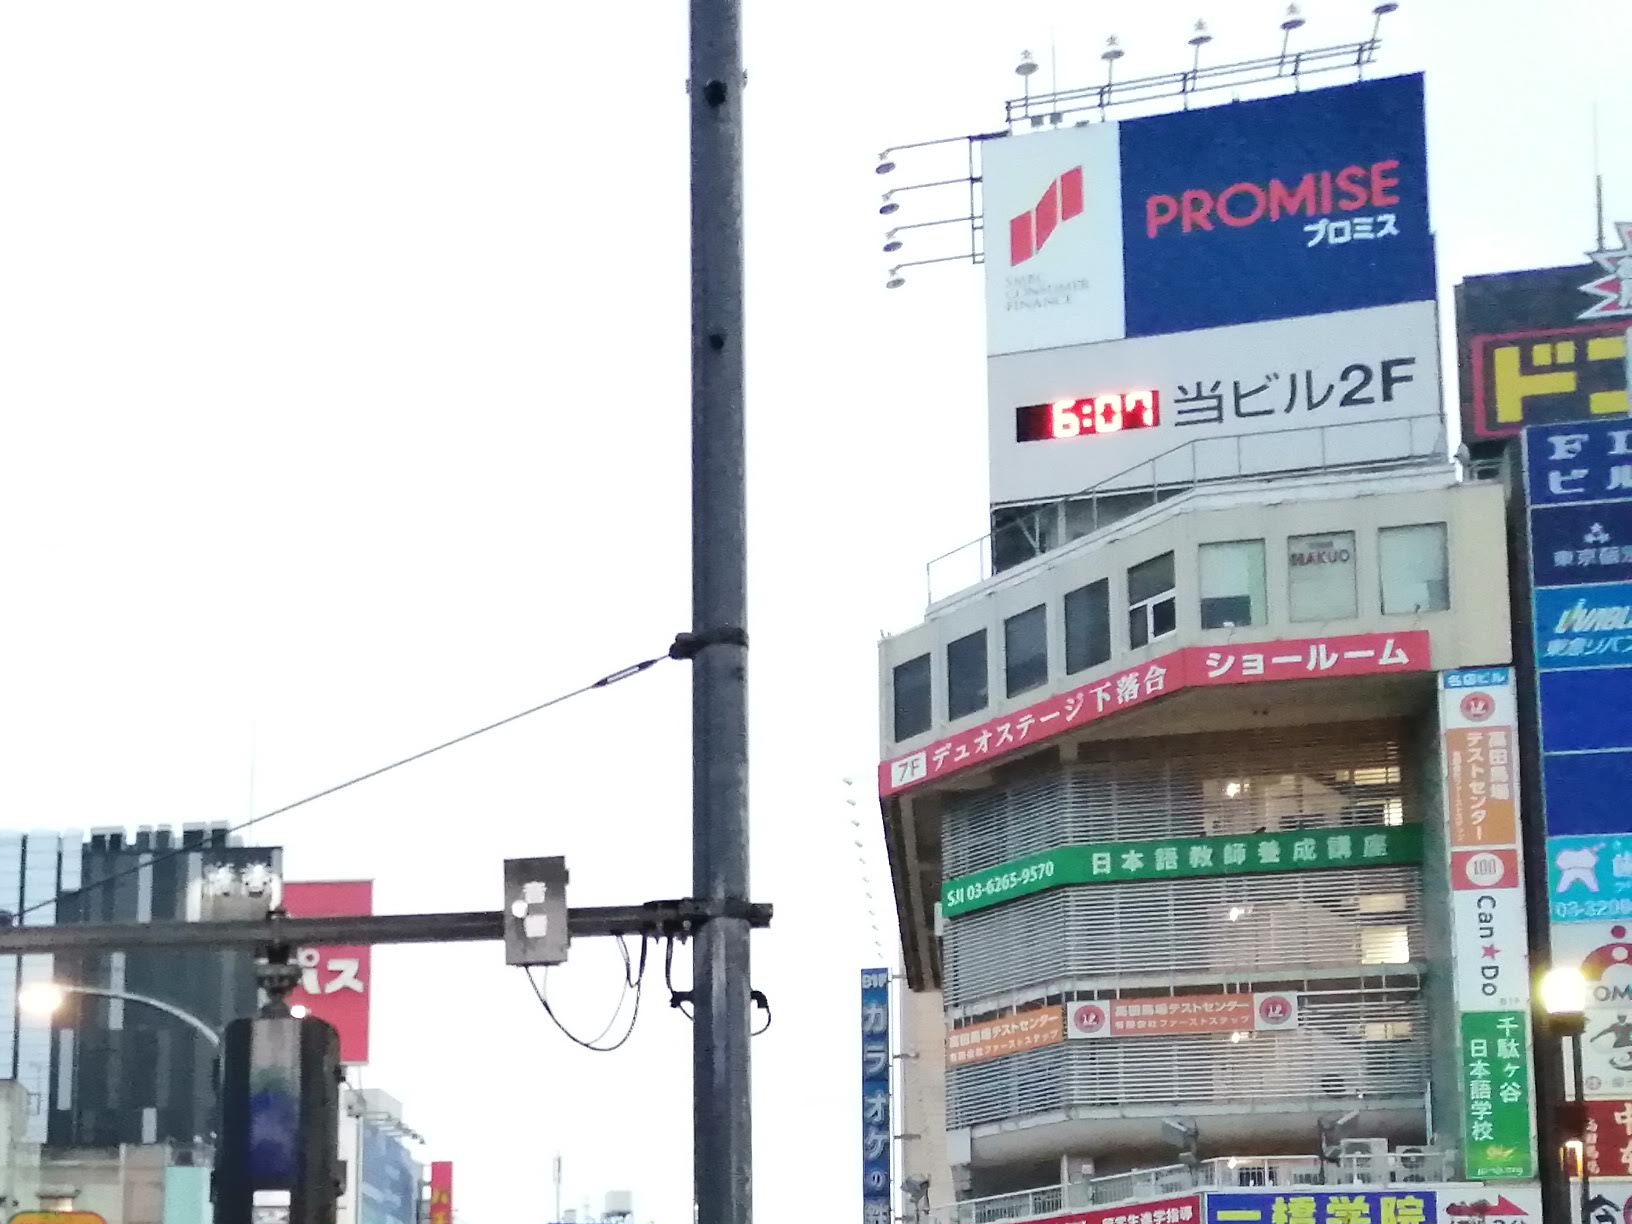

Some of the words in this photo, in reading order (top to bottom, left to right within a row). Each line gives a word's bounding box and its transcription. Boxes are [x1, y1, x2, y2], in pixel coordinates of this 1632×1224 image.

[1146, 159, 1400, 239] PROMISE
[1303, 213, 1400, 248] プロミス
[1052, 390, 1154, 439] 6:07
[1174, 357, 1417, 427] 当ビル2F
[896, 759, 922, 784] 7F
[932, 663, 1168, 773] デュオステージ下落合
[1205, 637, 1410, 678] ショールーム
[1466, 732, 1487, 841] テストセンター
[1092, 834, 1388, 876] 日本語教師養成講座
[966, 860, 1055, 903] 03-6265-9570
[1477, 894, 1497, 939] Can
[1480, 964, 1498, 997] Do
[1469, 1038, 1495, 1142] 日本語学校
